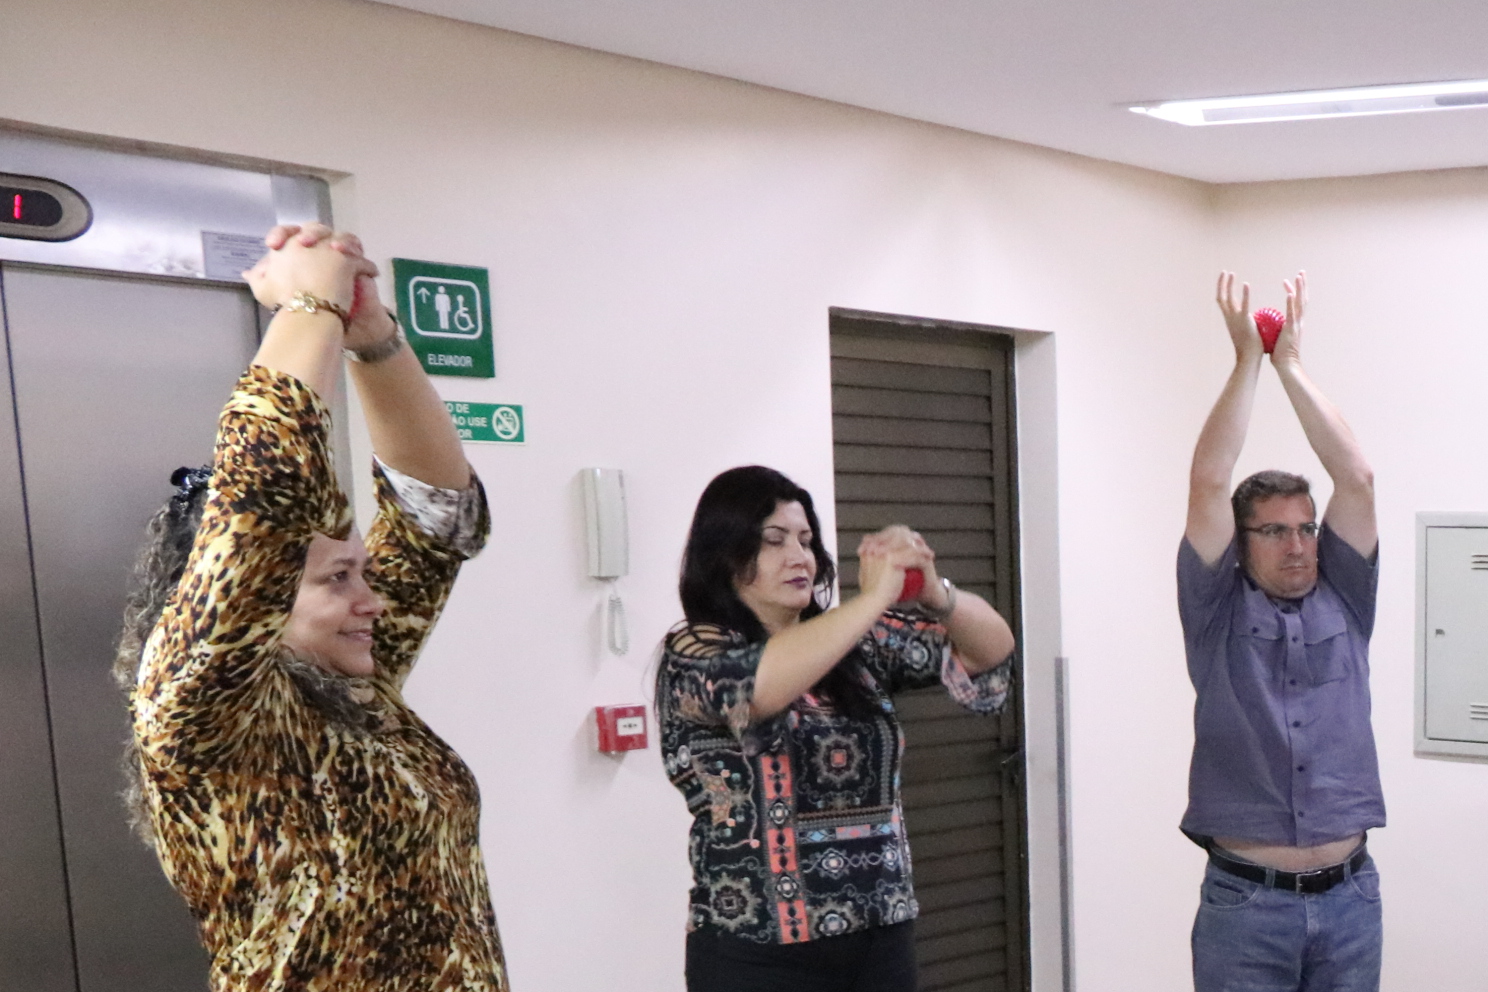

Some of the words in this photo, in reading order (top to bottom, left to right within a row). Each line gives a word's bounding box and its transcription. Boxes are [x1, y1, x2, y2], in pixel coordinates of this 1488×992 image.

[427, 353, 473, 368] ELEVADOR
[455, 403, 470, 414] DE
[467, 417, 488, 428] USE
